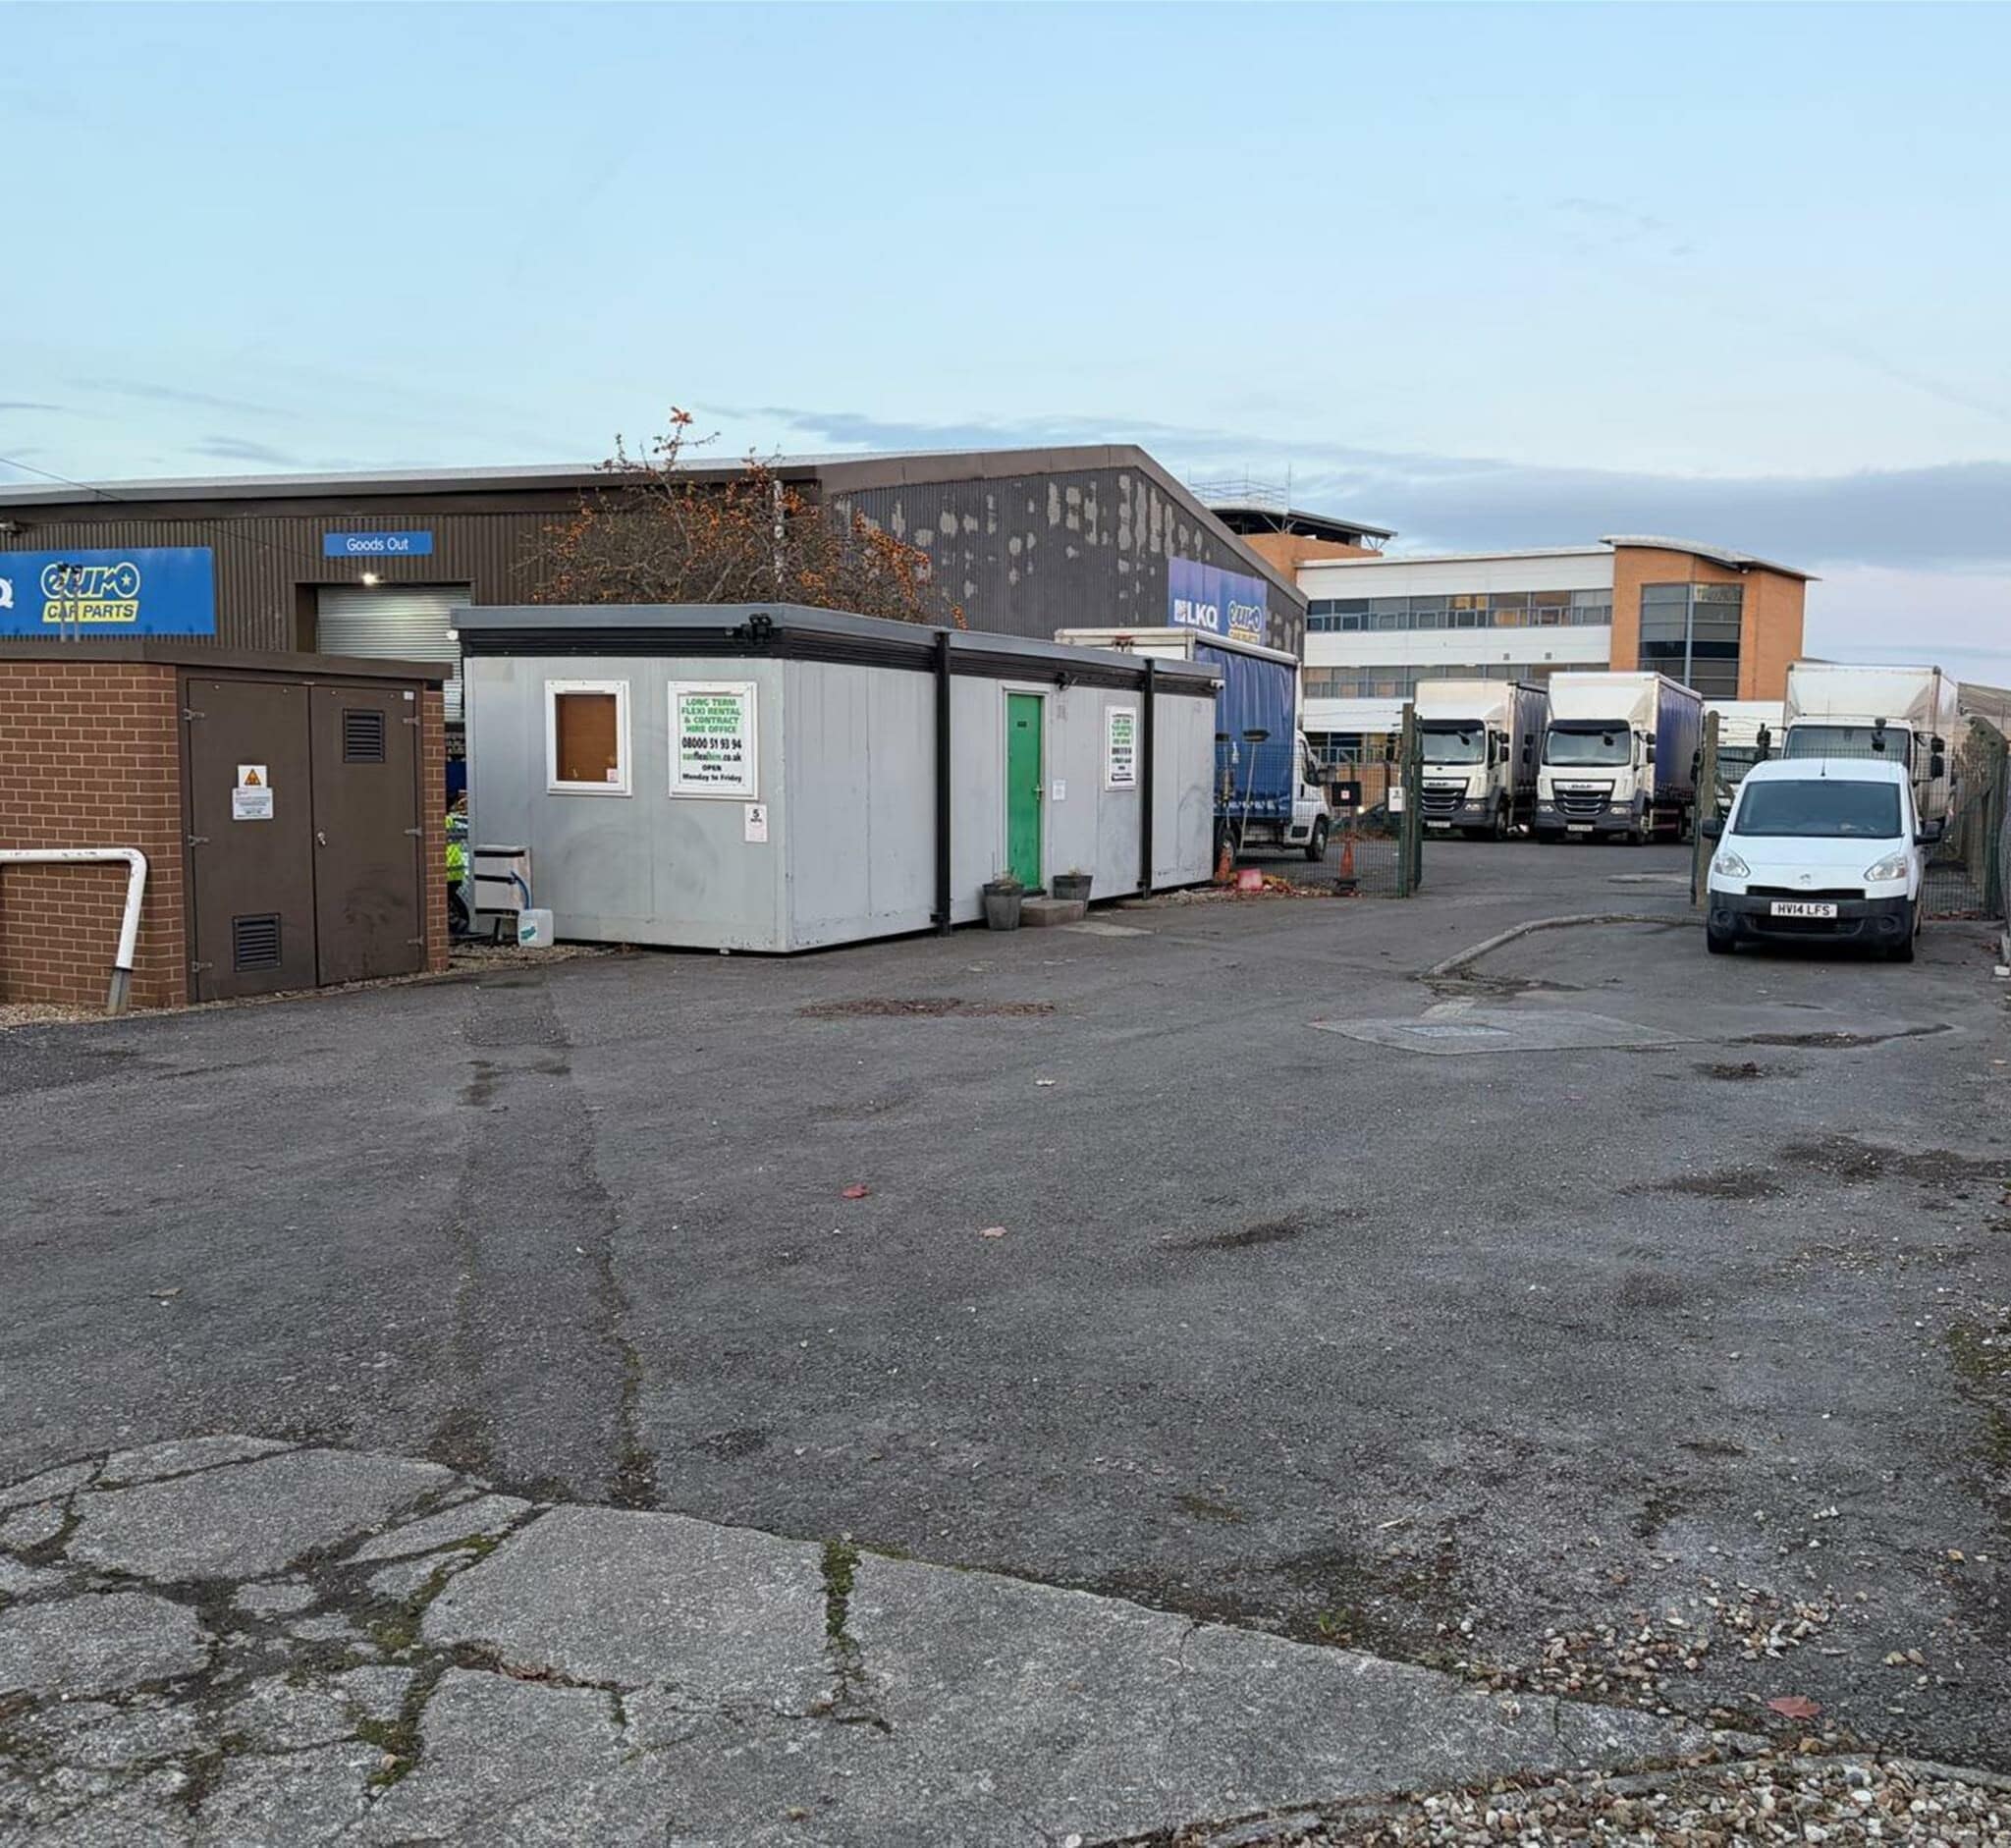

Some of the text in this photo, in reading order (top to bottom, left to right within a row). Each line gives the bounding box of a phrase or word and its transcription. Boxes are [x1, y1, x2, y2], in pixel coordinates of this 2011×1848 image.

[347, 537, 408, 552] Goods Out
[82, 604, 135, 619] PARTS
[1187, 600, 1218, 630] LKQ
[681, 707, 741, 716] FLEXI RENTAL
[693, 716, 739, 725] CONTRACT
[682, 773, 709, 783] Monday
[720, 774, 742, 784] Friday
[1777, 903, 1830, 916] HV14 LFS
